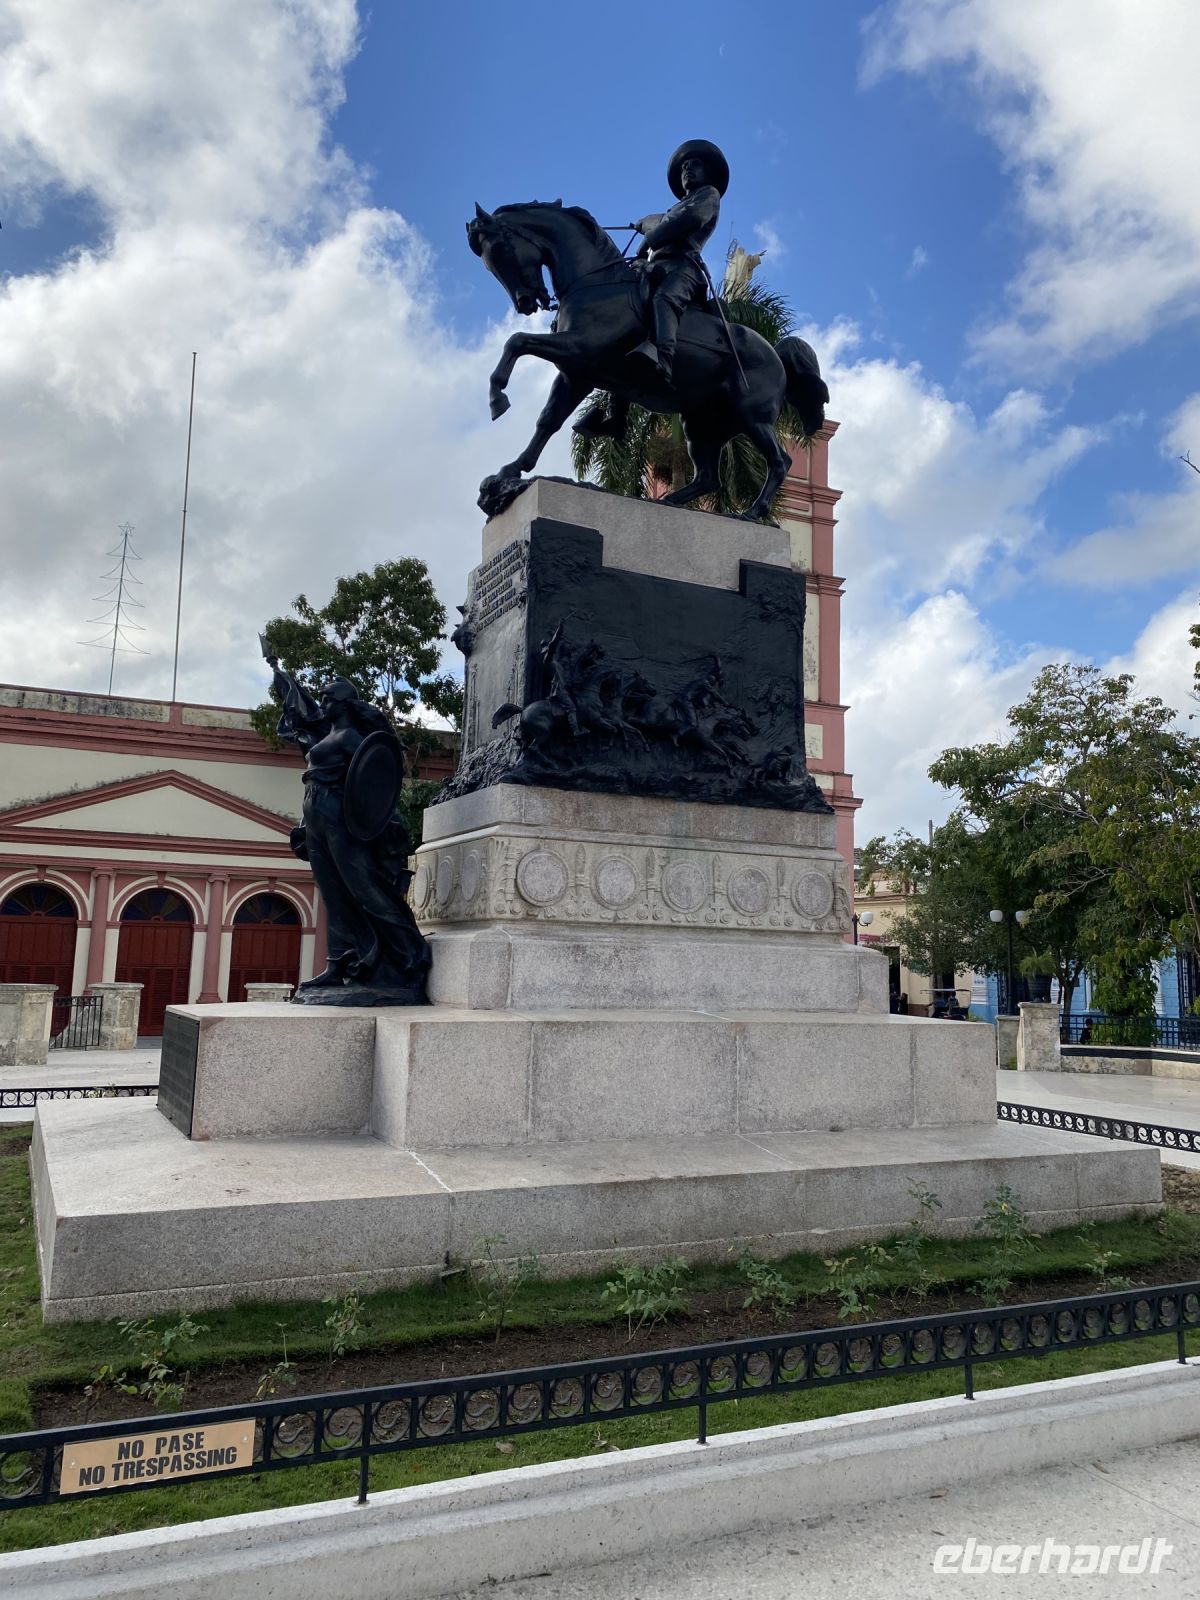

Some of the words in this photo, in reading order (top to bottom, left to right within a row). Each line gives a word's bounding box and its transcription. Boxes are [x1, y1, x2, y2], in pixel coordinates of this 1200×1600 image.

[118, 1440, 144, 1460] NO
[156, 1432, 205, 1454] PASE
[79, 1465, 105, 1486] NO
[112, 1446, 237, 1481] TRESPASSING
